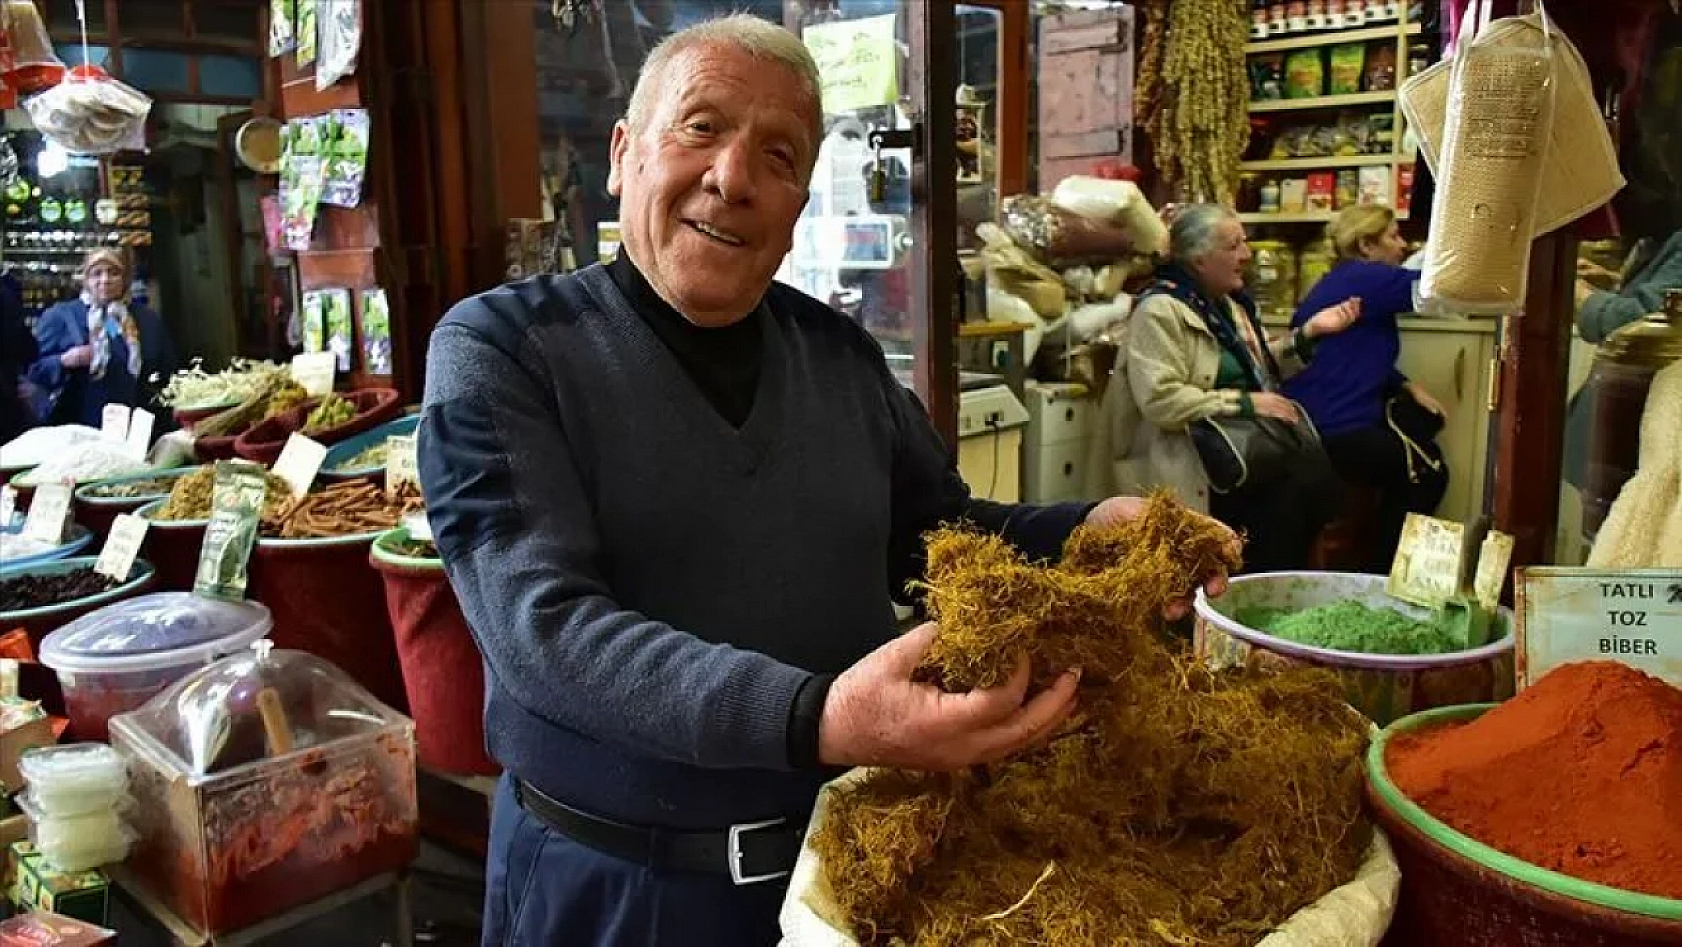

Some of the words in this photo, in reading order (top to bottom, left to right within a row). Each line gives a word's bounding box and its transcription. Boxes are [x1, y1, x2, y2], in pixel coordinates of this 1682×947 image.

[1600, 583, 1654, 599] TATLI
[1607, 610, 1648, 626] TOZ
[1599, 634, 1658, 655] BİBER
